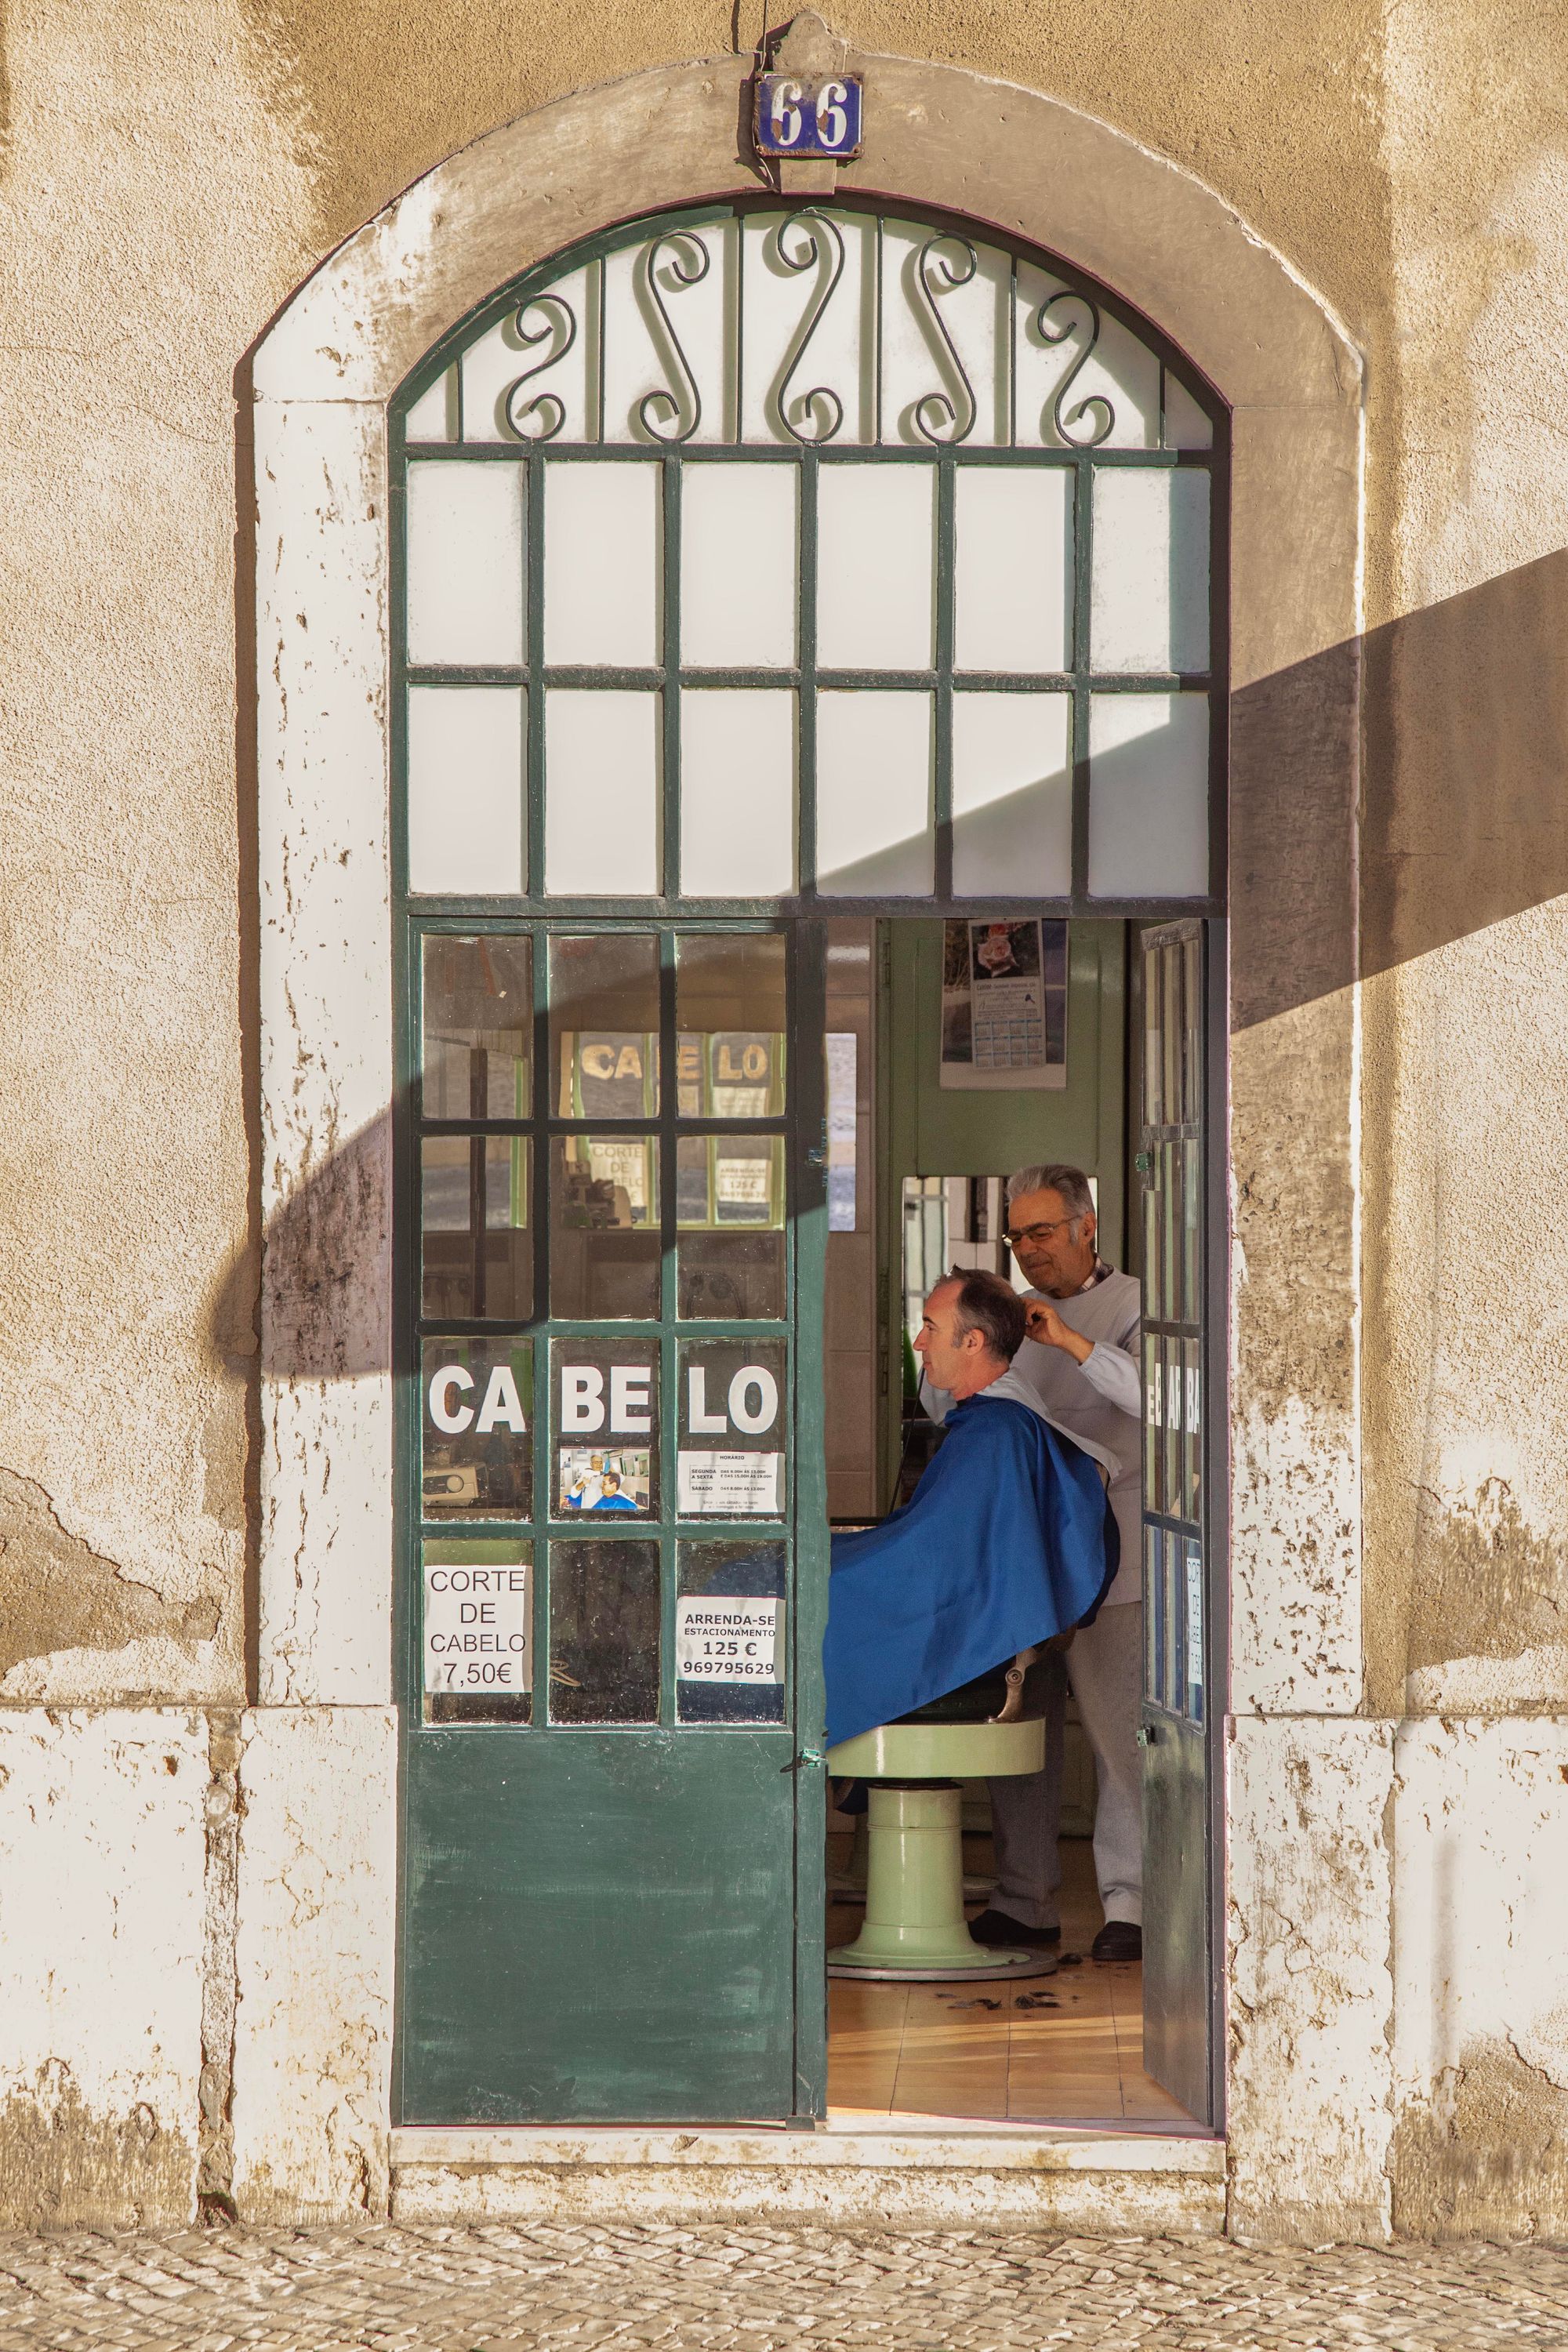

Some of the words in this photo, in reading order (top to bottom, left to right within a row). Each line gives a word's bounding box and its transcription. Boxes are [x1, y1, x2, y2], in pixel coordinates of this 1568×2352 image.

[771, 82, 848, 147] 66
[430, 1570, 525, 1592] CORTE
[460, 1602, 496, 1624] DE
[684, 1614, 775, 1626] ARRENDA-SE
[684, 1628, 775, 1637] ESTACIONAMENTO
[430, 1634, 526, 1653] CABELO
[703, 1641, 739, 1656] 125
[745, 1642, 757, 1656] €
[444, 1662, 512, 1687] 7,50€
[683, 1661, 775, 1675] 969795629
